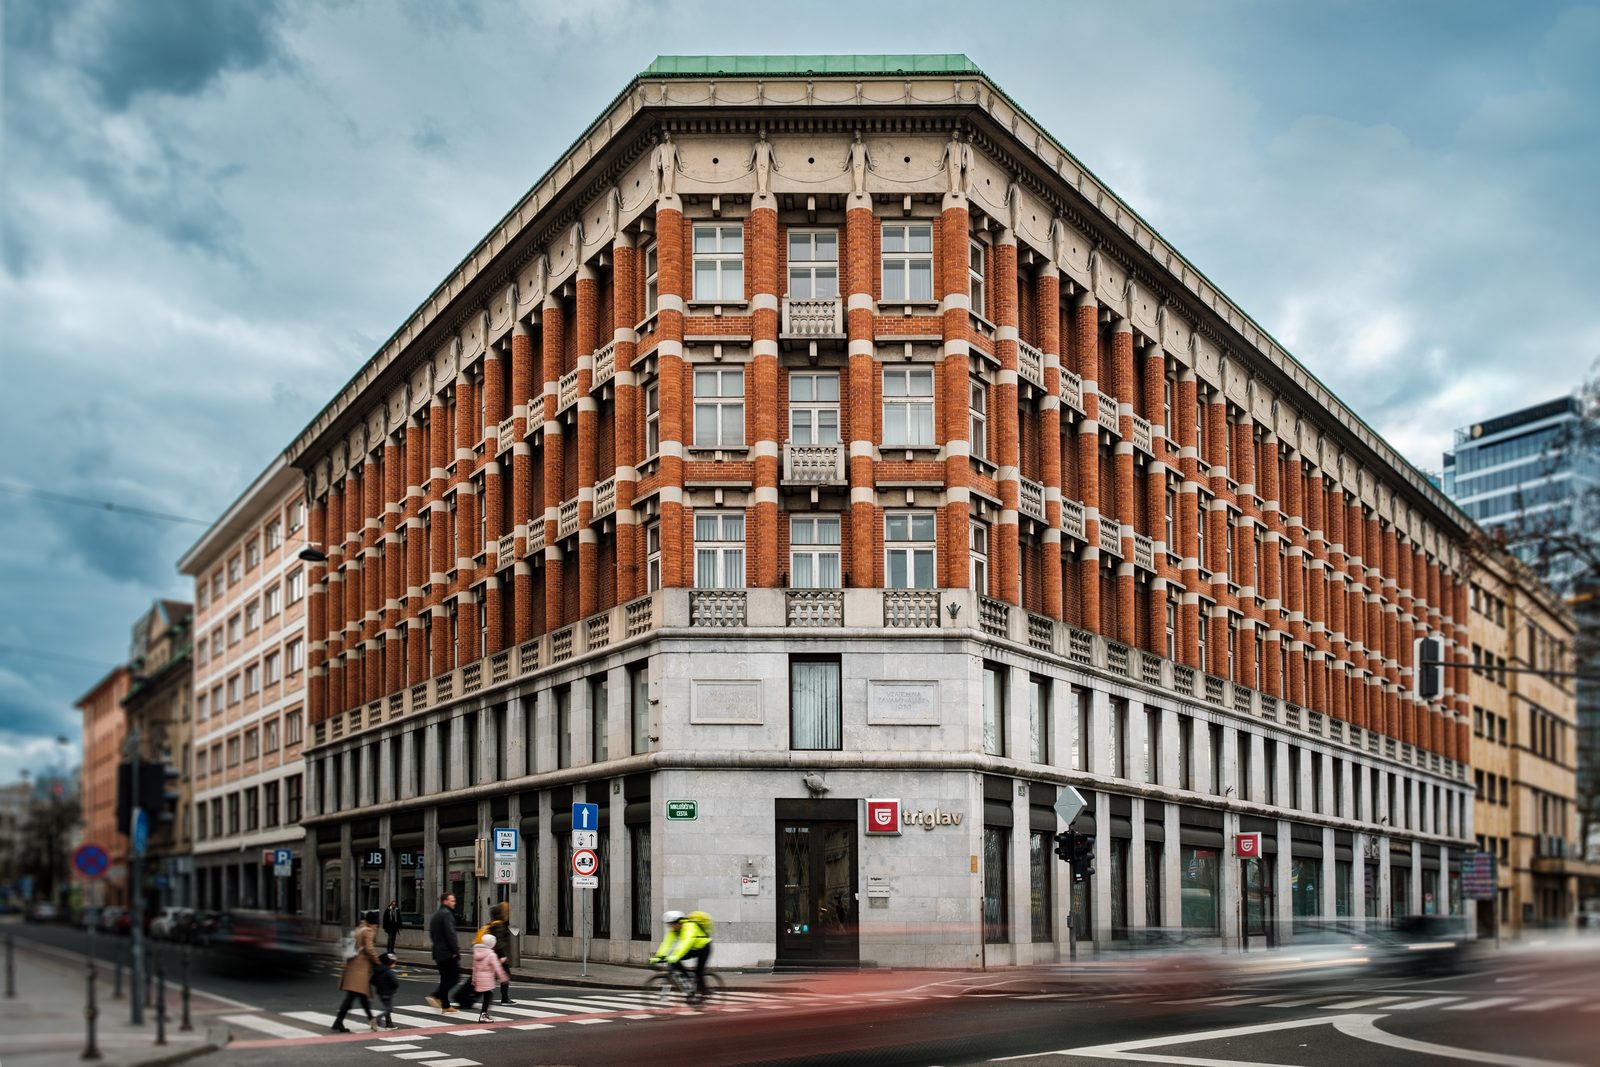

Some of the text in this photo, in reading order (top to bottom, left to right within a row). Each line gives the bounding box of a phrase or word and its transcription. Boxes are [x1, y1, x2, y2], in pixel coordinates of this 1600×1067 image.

[902, 807, 963, 831] triglav
[278, 851, 288, 863] P
[367, 852, 383, 864] JB
[500, 869, 510, 878] 30
